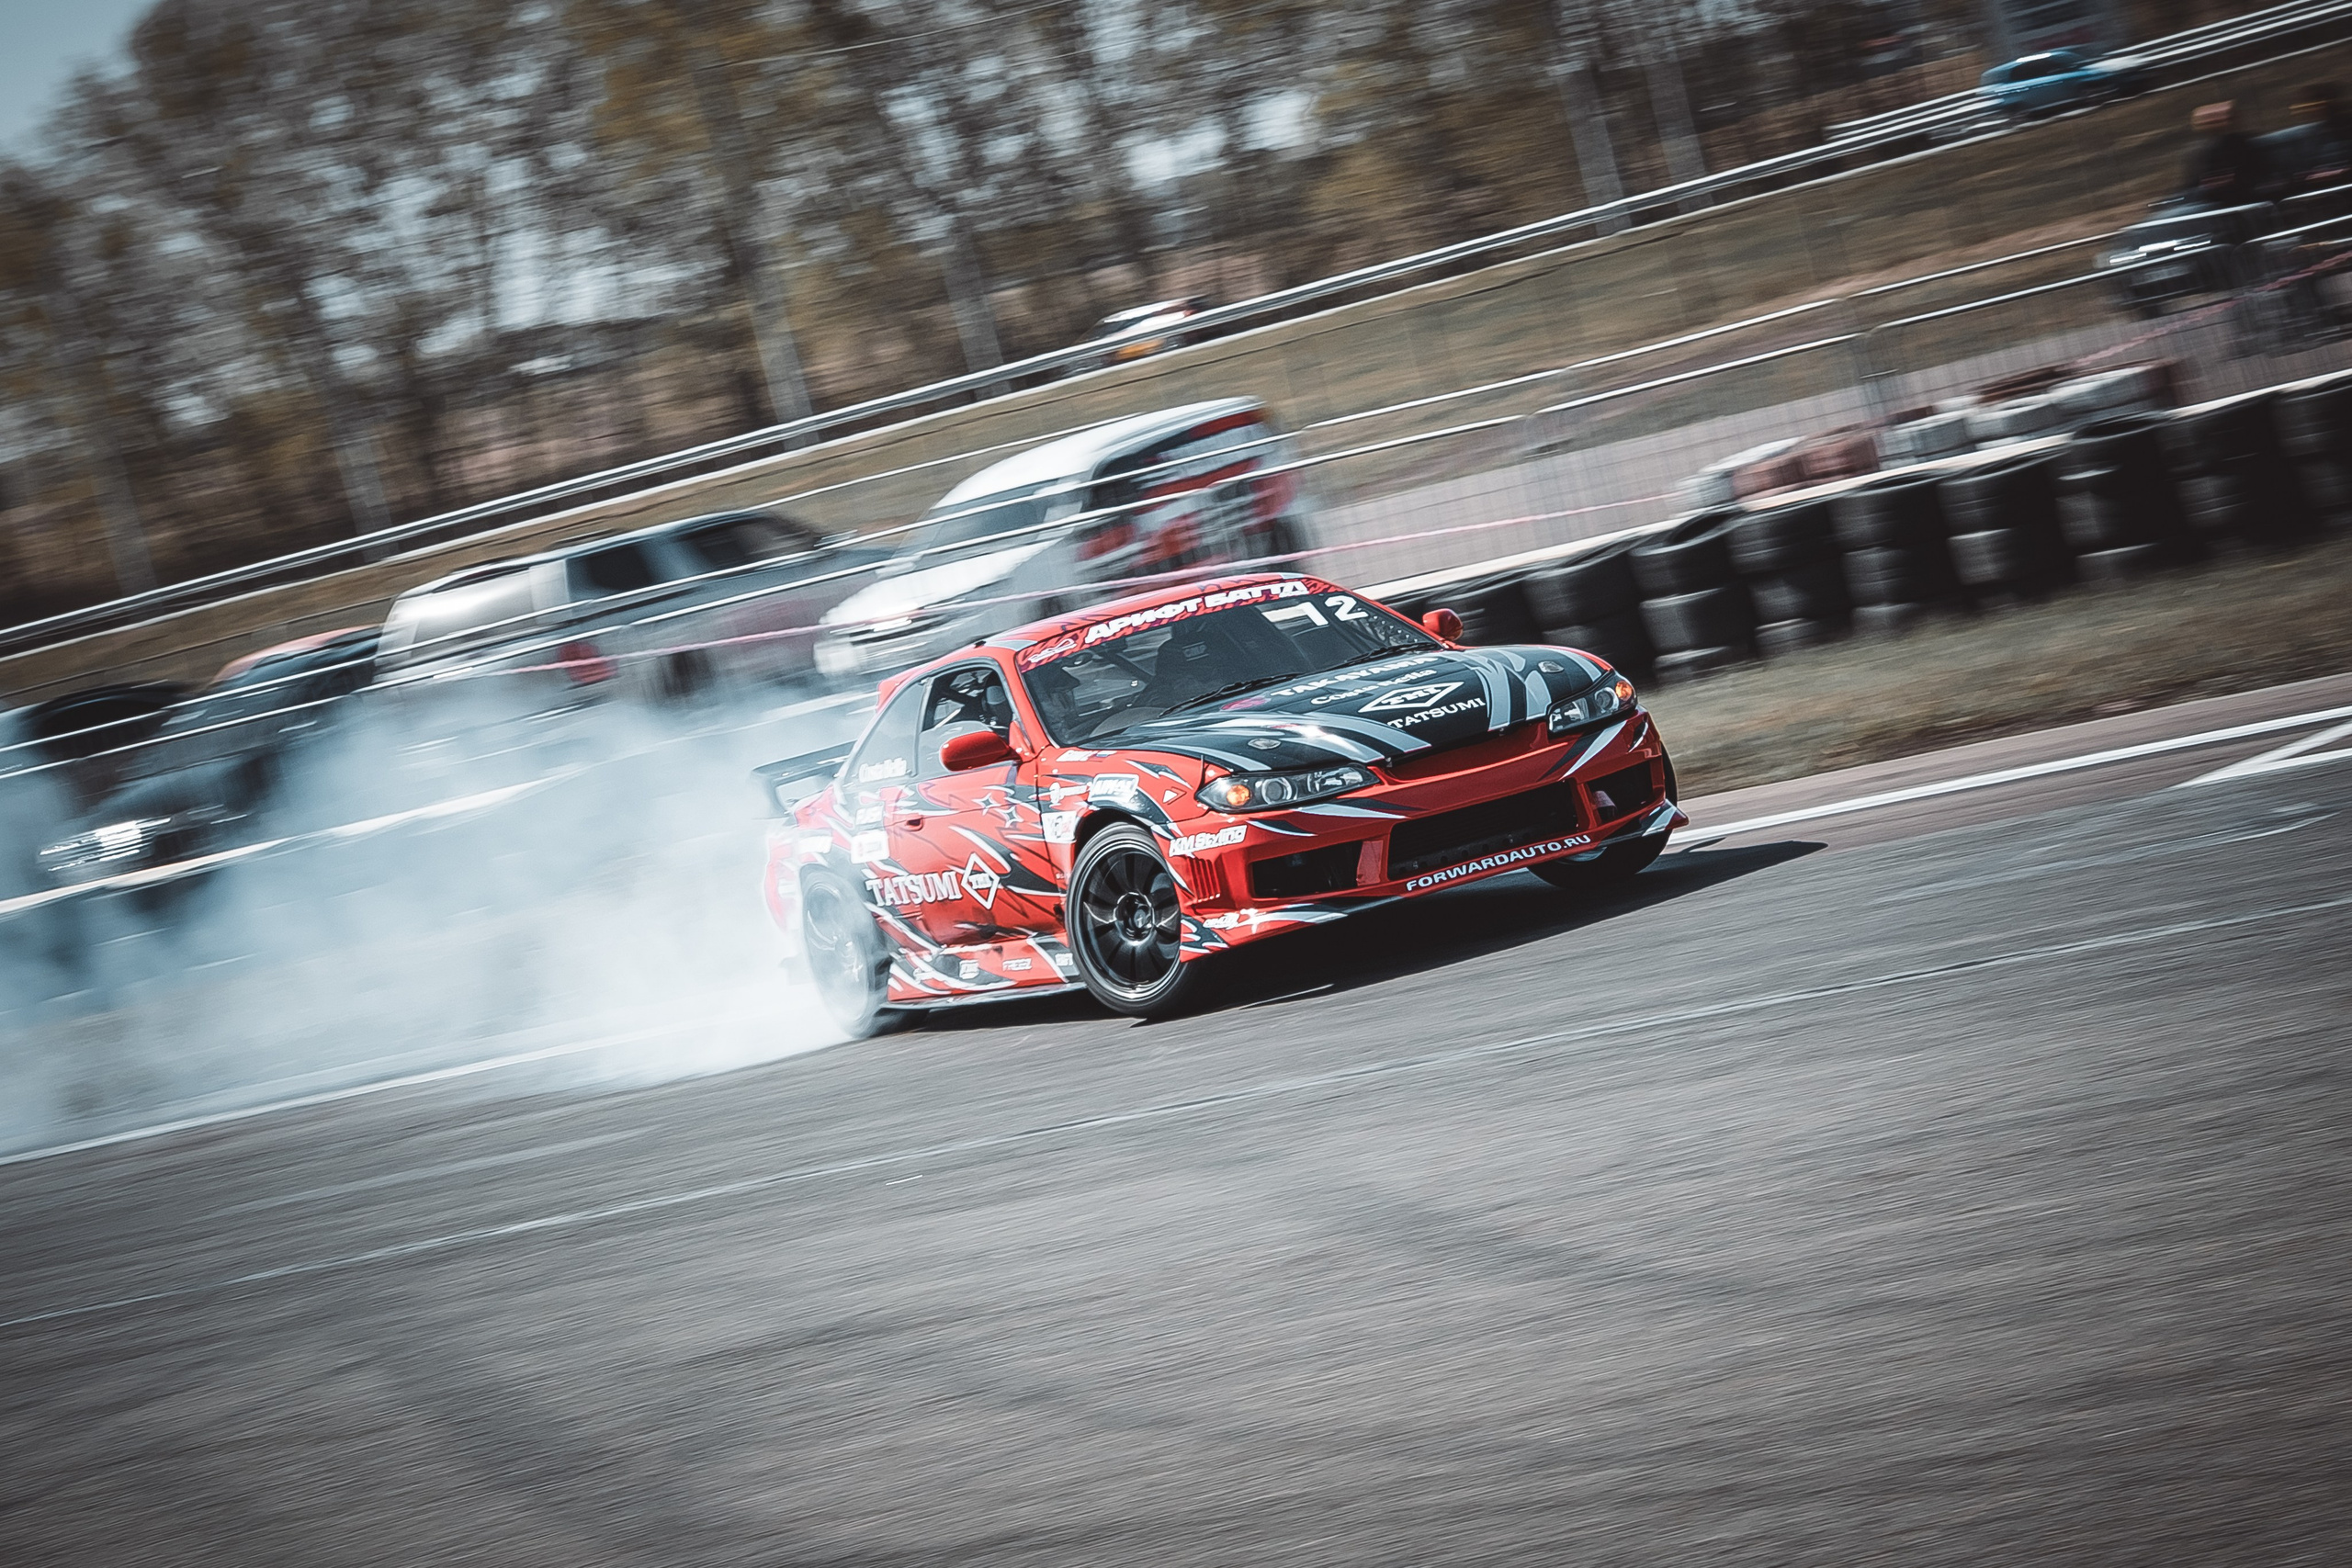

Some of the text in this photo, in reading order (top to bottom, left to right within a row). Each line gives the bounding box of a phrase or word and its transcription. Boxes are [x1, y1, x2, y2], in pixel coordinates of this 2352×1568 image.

[1271, 657, 1439, 696] TAKAYAMA
[1387, 698, 1487, 728] TATSUMI
[1406, 834, 1591, 891] FORWARDAUTO.RU
[865, 871, 963, 907] TATSUMI
